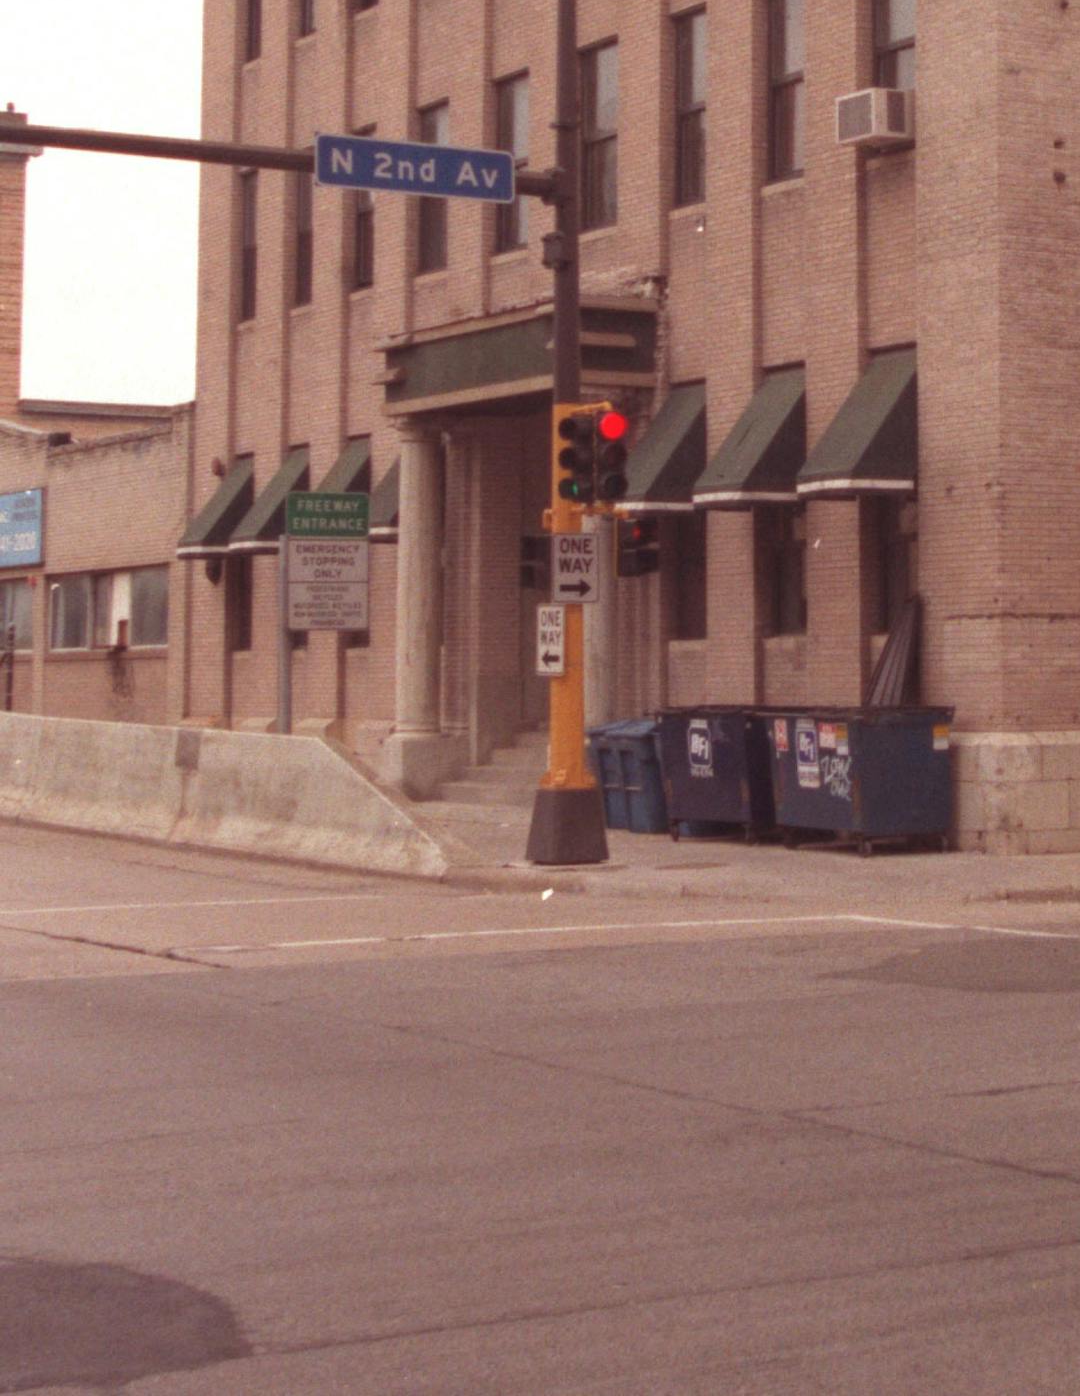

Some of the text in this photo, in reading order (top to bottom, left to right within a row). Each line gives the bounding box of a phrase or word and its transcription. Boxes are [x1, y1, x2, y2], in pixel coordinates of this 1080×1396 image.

[331, 148, 498, 189] N 2nd Av
[296, 499, 360, 512] FREEWAY
[292, 517, 364, 531] ENTRANCE
[296, 543, 360, 555] EMERGENCY
[559, 538, 593, 554] ONE
[302, 556, 356, 567] STOPPING
[558, 558, 594, 574] WAY
[314, 568, 342, 579] ONLY
[540, 610, 561, 627] ONE
[540, 630, 561, 646] WAY
